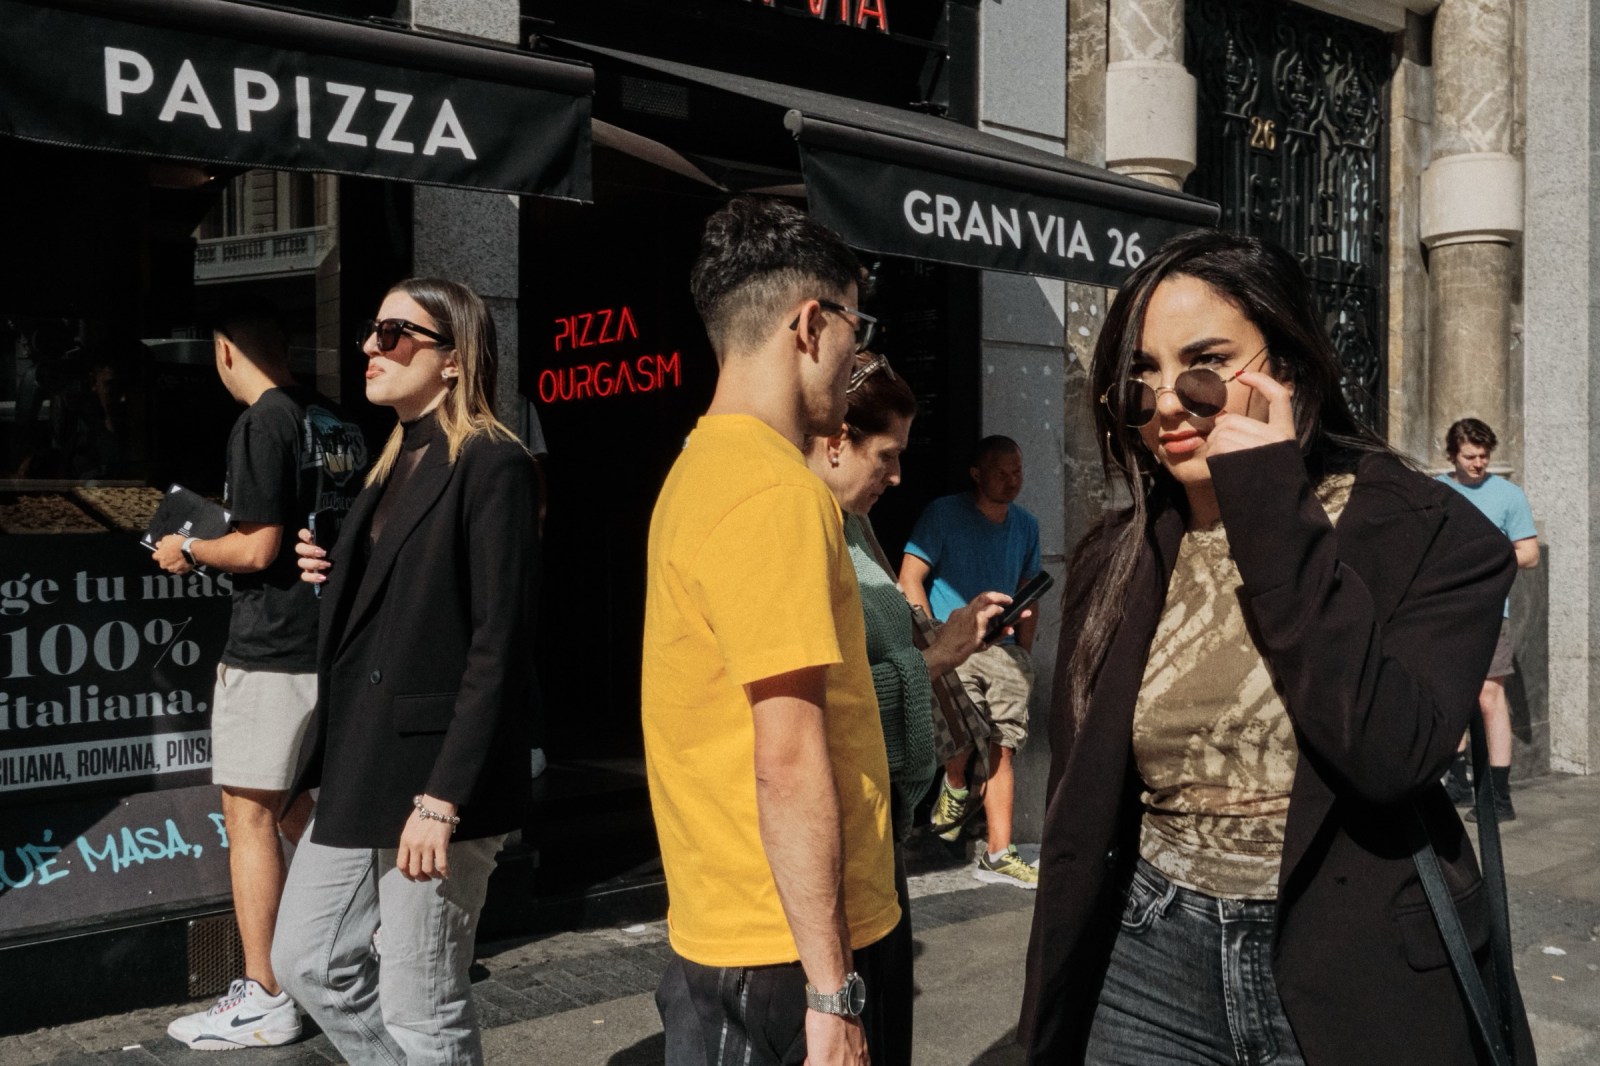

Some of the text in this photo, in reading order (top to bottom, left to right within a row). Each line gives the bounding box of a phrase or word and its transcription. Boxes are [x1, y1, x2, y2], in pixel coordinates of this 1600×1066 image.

[103, 46, 478, 161] PAPIZZA
[1251, 116, 1275, 150] 26
[903, 189, 1146, 269] GRAN VIA 26
[554, 306, 639, 352] PIZZA
[538, 352, 682, 403] OURGASM
[73, 570, 126, 604] tu
[1, 616, 201, 680] 100%
[0, 684, 208, 731] italiana.
[0, 751, 72, 787] ILIANA,
[77, 742, 161, 778] ROMANA,
[0, 828, 70, 891] UÉ
[76, 818, 203, 873] MASA,
